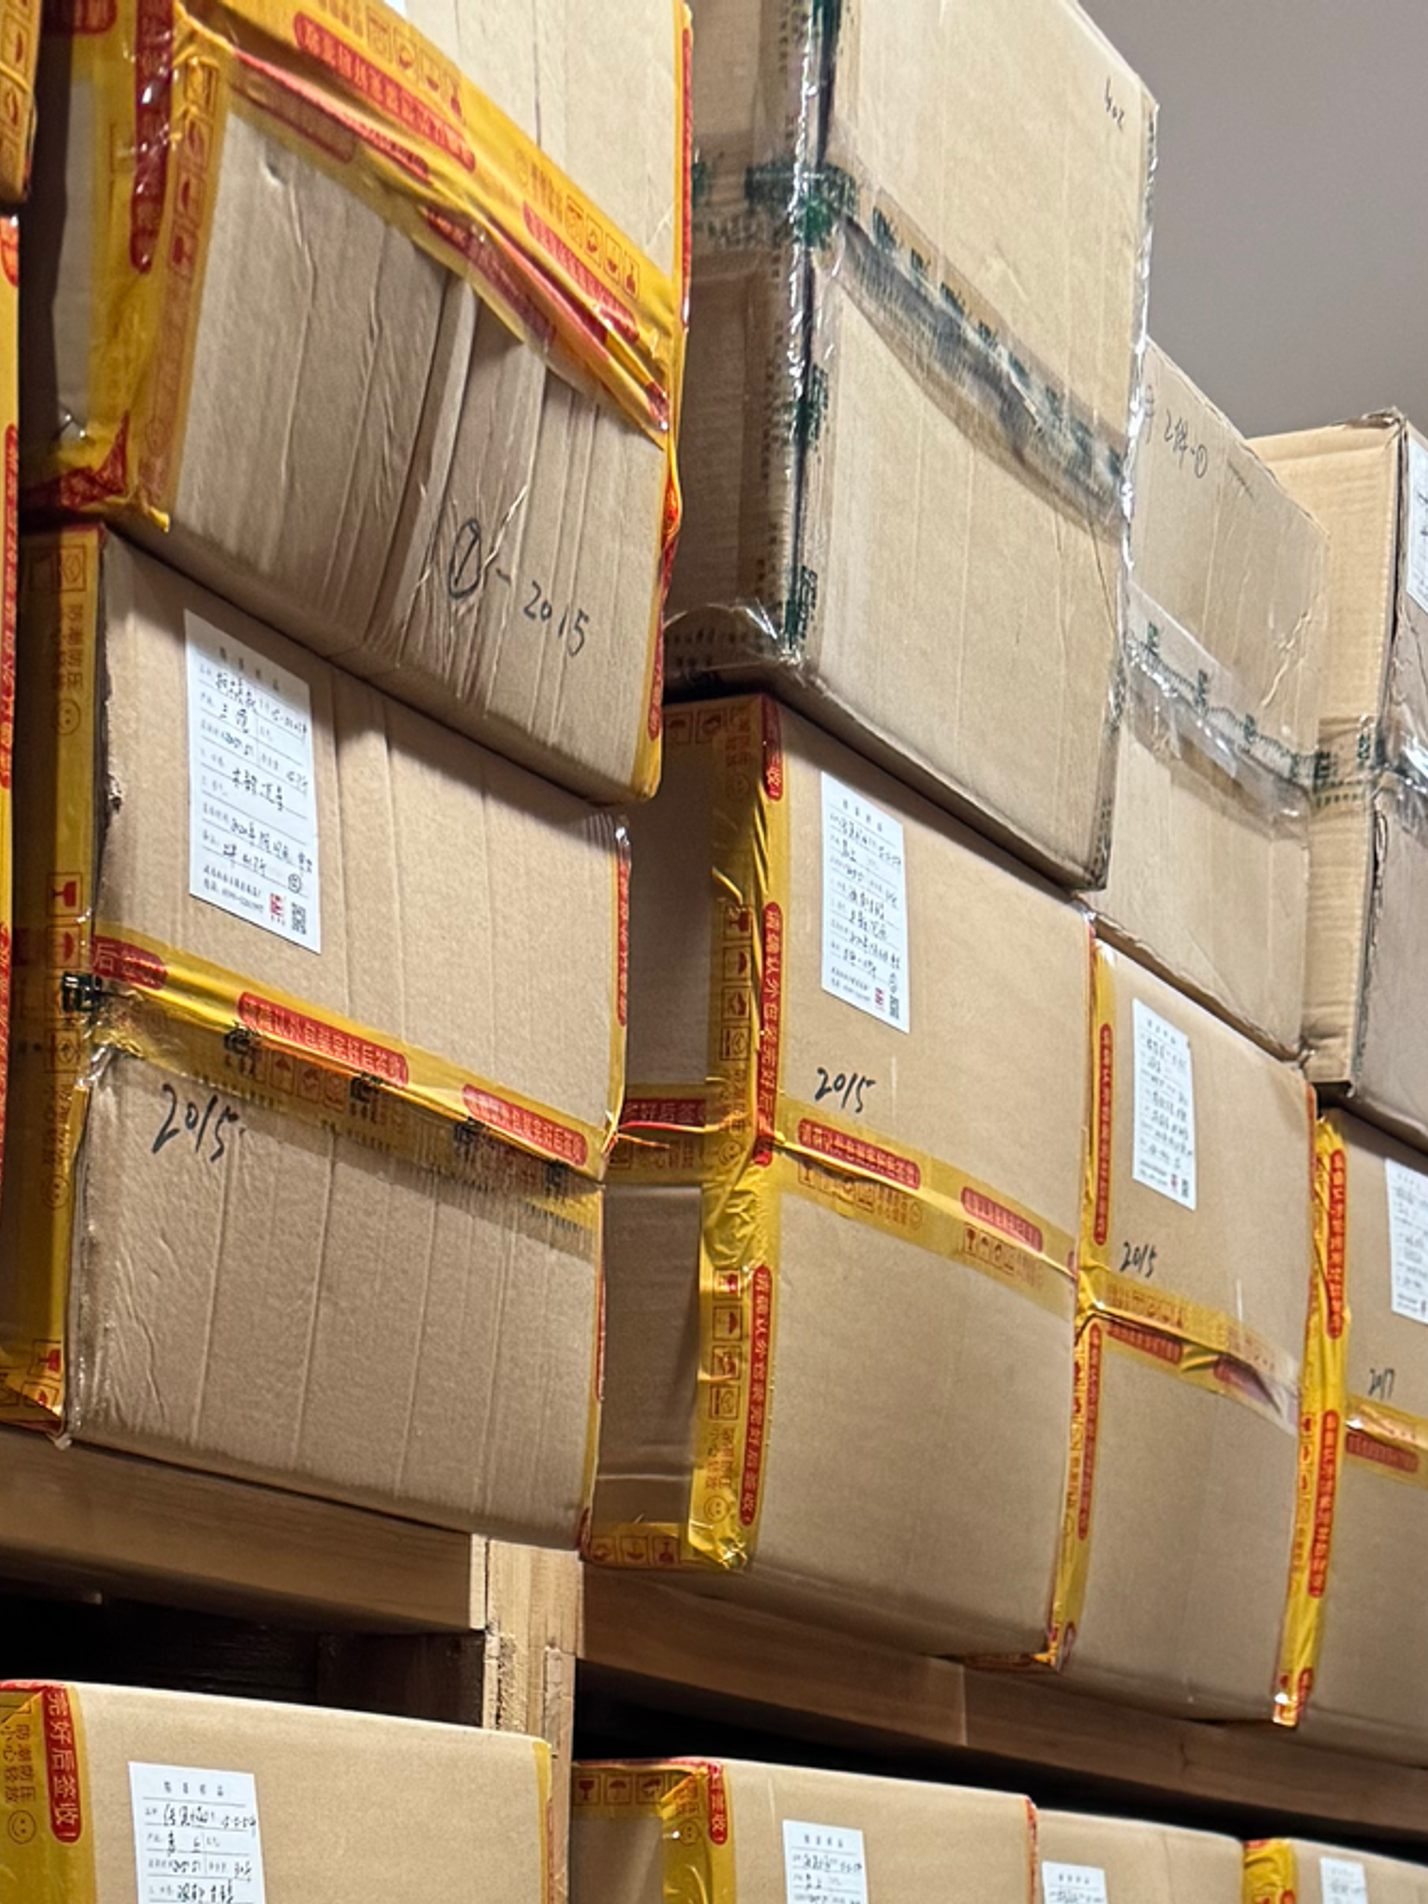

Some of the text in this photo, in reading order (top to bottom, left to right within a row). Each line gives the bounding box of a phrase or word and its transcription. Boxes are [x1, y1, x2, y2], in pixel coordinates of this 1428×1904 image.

[815, 1068, 876, 1115] 2015
[151, 1083, 243, 1162] 2015
[1120, 1240, 1157, 1279] 2015
